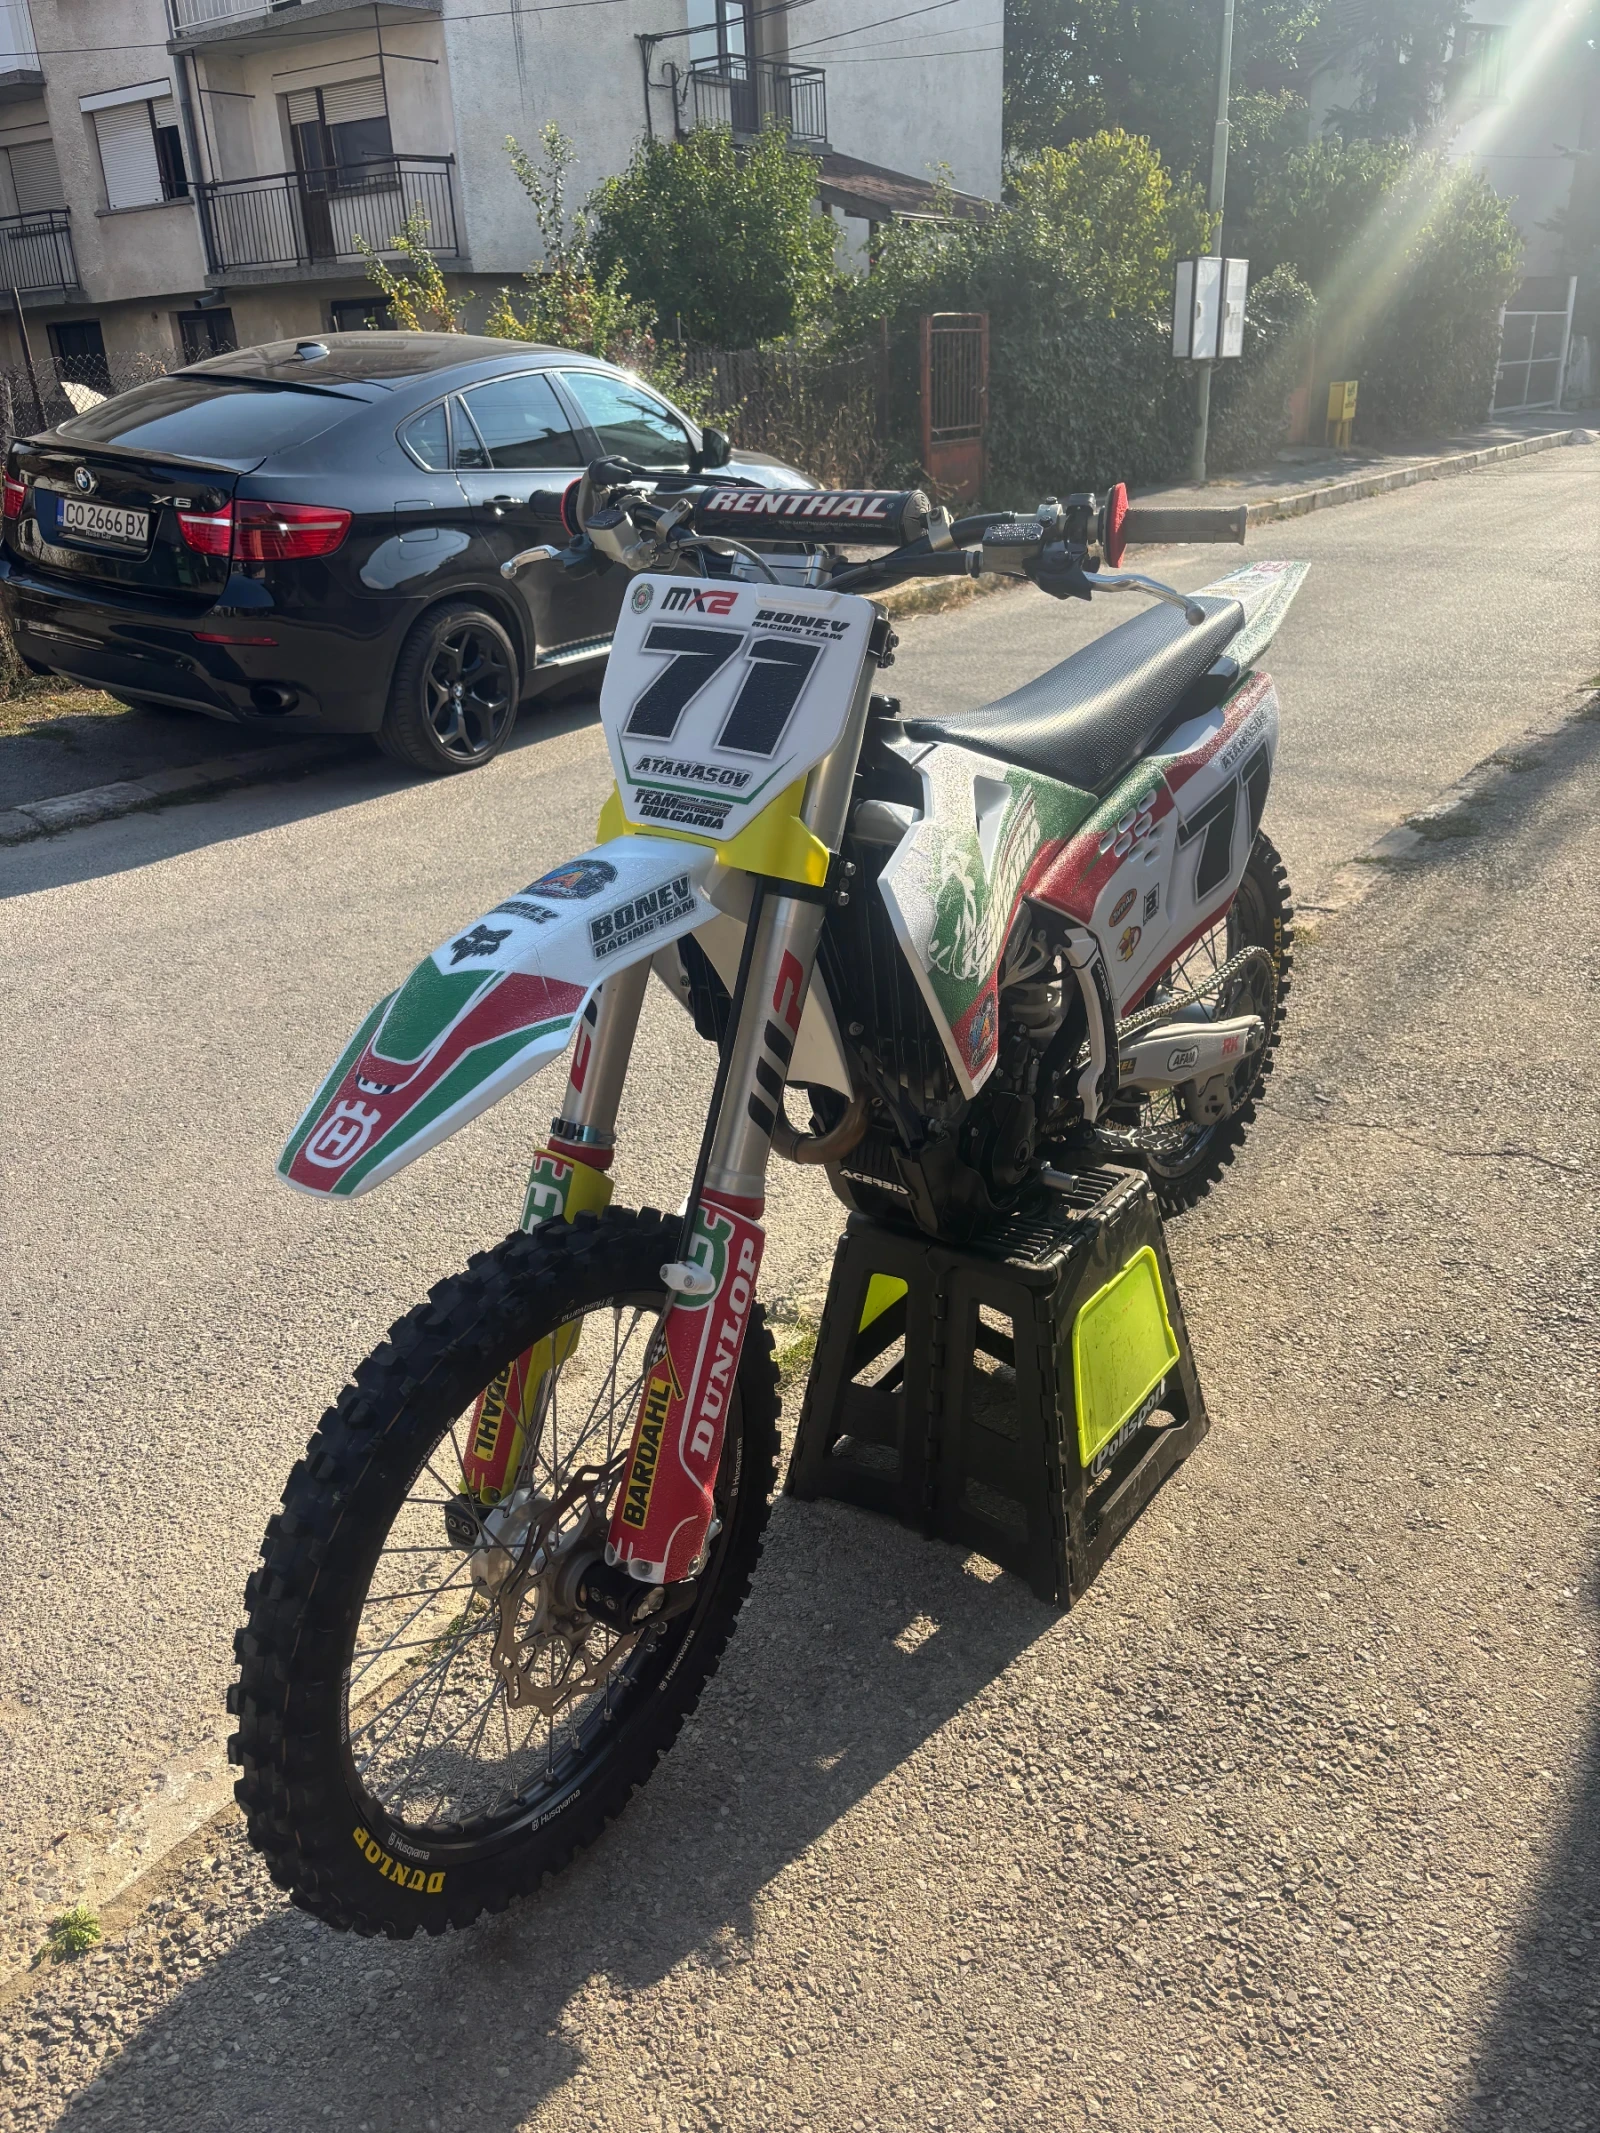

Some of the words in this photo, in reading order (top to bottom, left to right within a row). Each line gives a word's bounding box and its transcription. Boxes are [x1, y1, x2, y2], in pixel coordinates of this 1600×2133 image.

[150, 493, 192, 508] X6
[705, 491, 887, 518] RENTHAL
[66, 503, 85, 526] CO
[87, 508, 123, 533] 2666
[126, 513, 146, 539] BX
[660, 587, 739, 615] MX2
[751, 621, 802, 633] RACING
[805, 629, 843, 641] TEAM
[754, 609, 850, 632] BONEV
[635, 757, 751, 788] ATANASOV
[634, 792, 681, 809] TEAM
[639, 804, 725, 830] BULGARIA
[590, 875, 689, 943] BONEV
[595, 917, 655, 958] RACING
[657, 898, 695, 926] TEAM
[1172, 1051, 1196, 1066] AFAM
[690, 1237, 758, 1462] DUNLOP
[623, 1384, 671, 1527] BARDAHL
[665, 1629, 695, 1681] Husqvarna
[540, 1789, 581, 1826] Husqvarna
[352, 1826, 446, 1893] DUNLOP
[394, 1836, 430, 1861] Husqvarna
